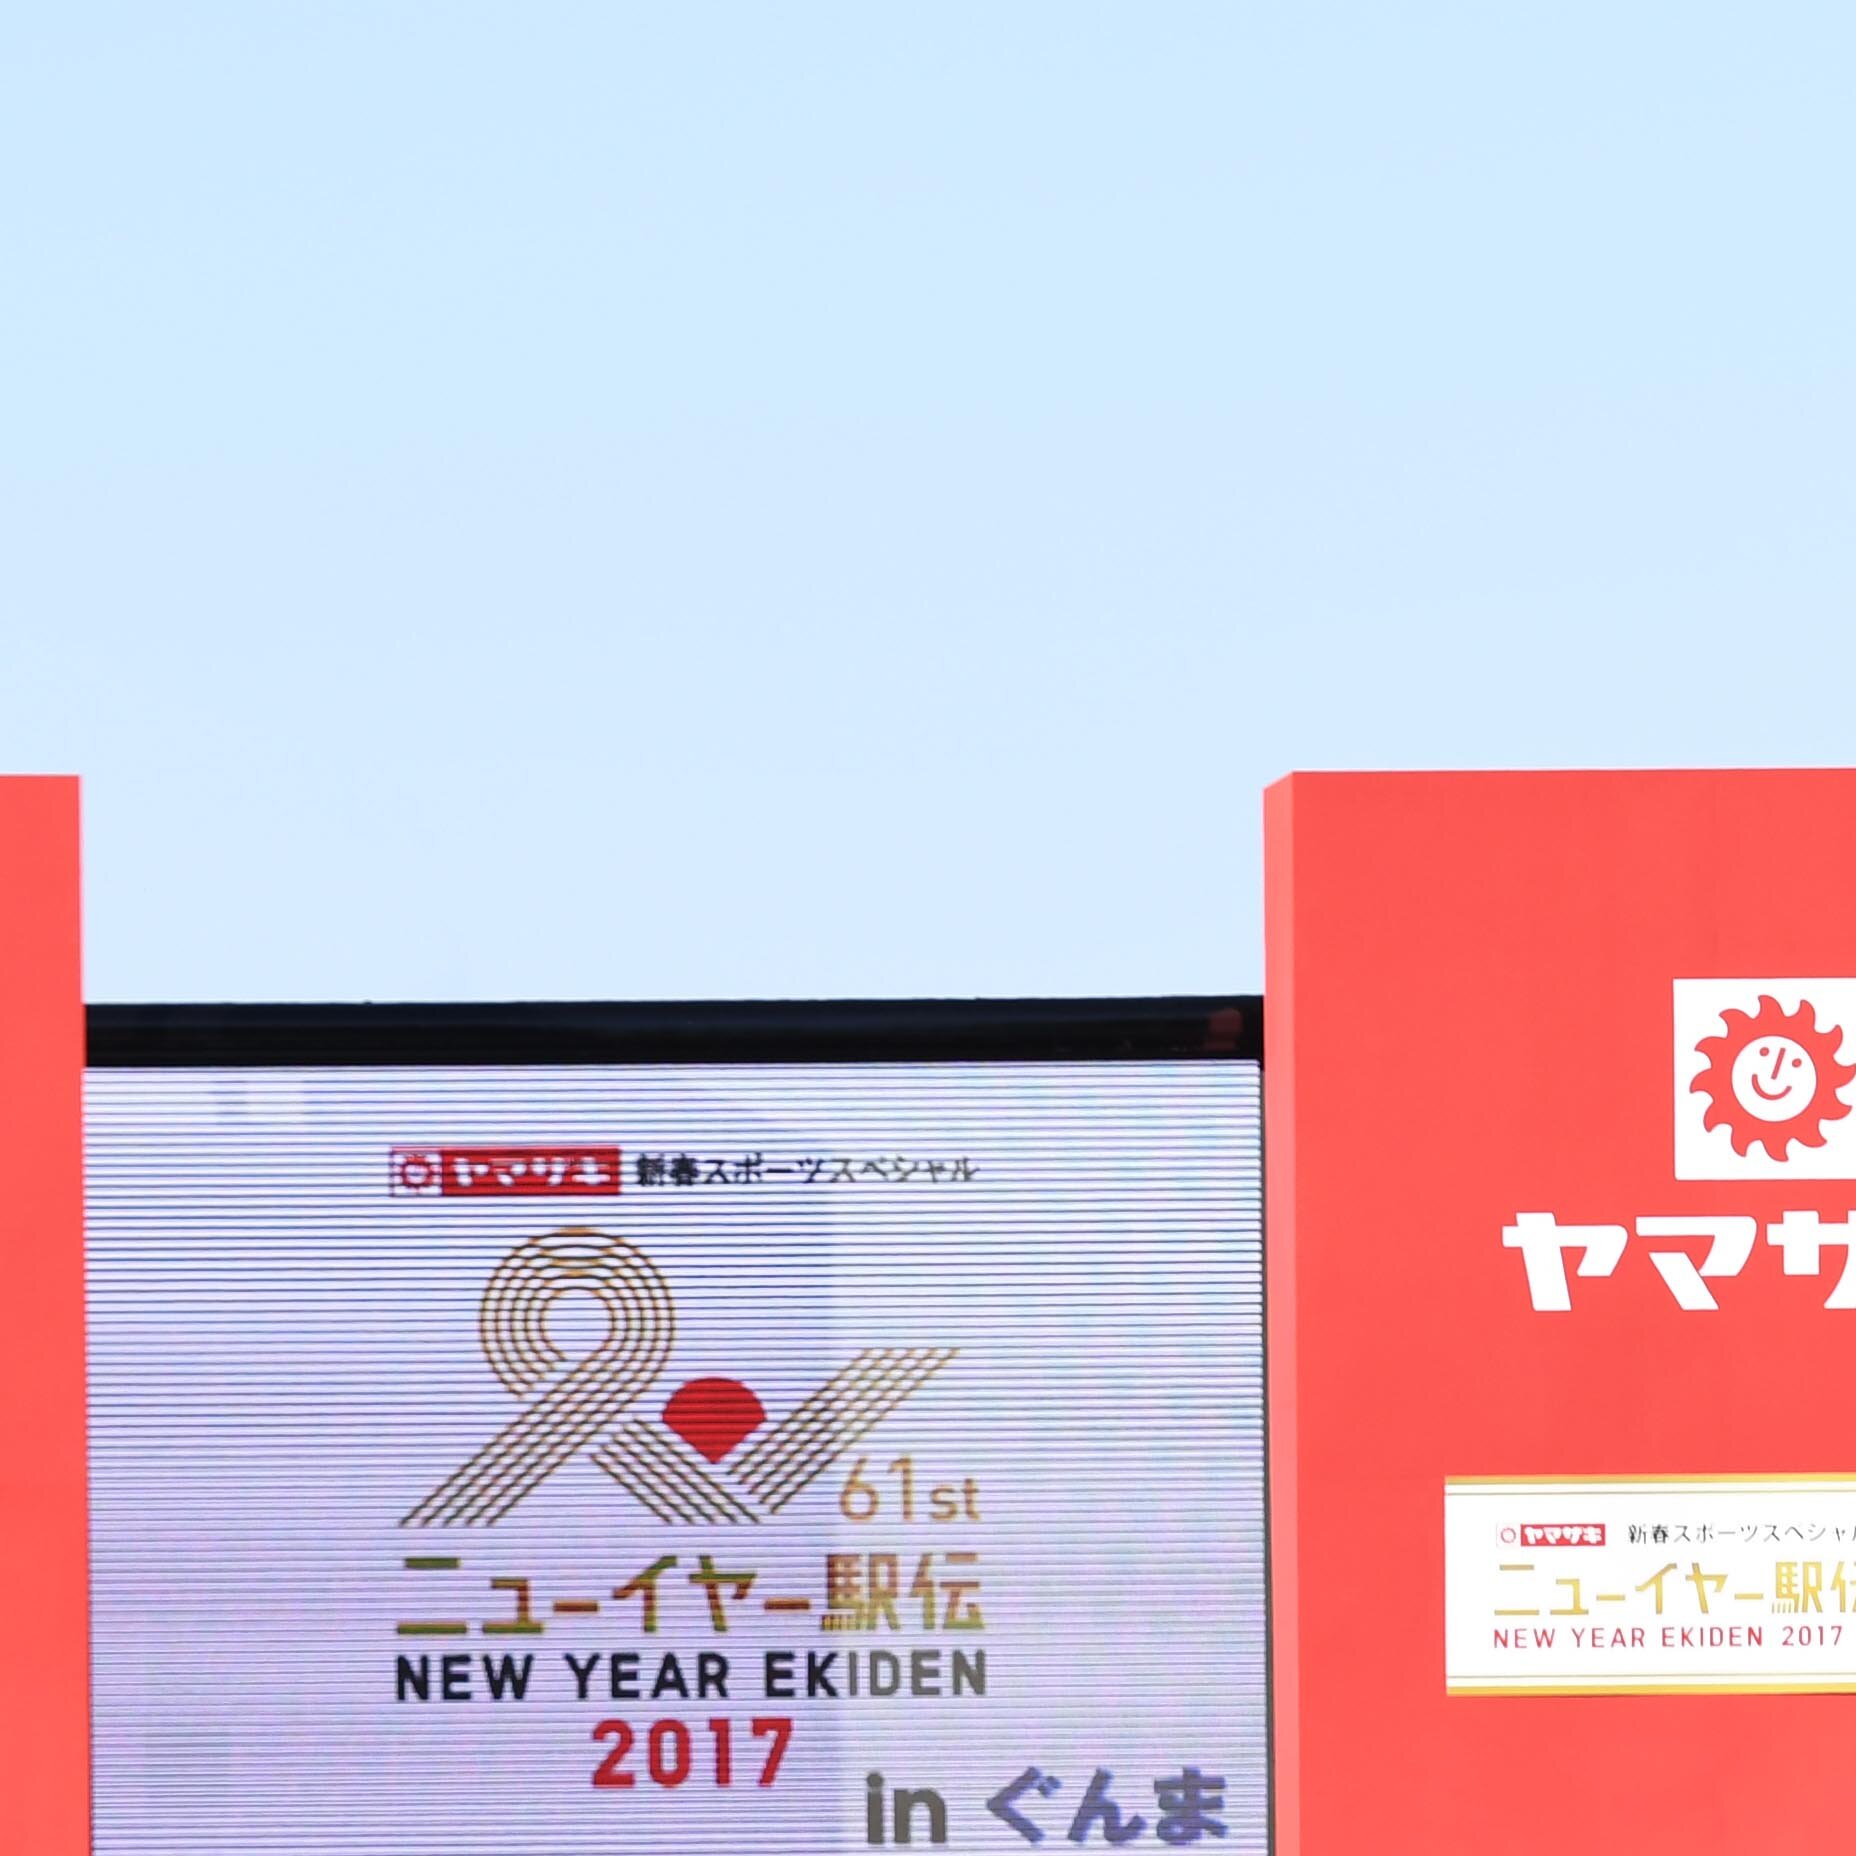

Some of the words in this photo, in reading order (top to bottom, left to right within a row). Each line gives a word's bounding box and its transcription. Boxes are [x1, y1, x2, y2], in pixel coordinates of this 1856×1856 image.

[452, 1156, 614, 1187] ヤマザキ
[635, 1152, 980, 1188] 新春スポーツスペシャル
[838, 1456, 980, 1522] 61st
[1524, 1525, 1603, 1545] ヤマザキ
[395, 1551, 986, 1637] ニューイヤー駅伝
[1494, 1626, 1557, 1650] NEW
[1572, 1626, 1646, 1650] YEAR
[1661, 1625, 1763, 1649] EKIDEN
[1782, 1625, 1844, 1648] 2017
[395, 1654, 534, 1702] NEW
[566, 1652, 730, 1701] YEAR
[764, 1649, 988, 1700] EKIDEN
[591, 1717, 794, 1789] 2017
[865, 1773, 947, 1846] in
[985, 1766, 1229, 1846] ぐんま
